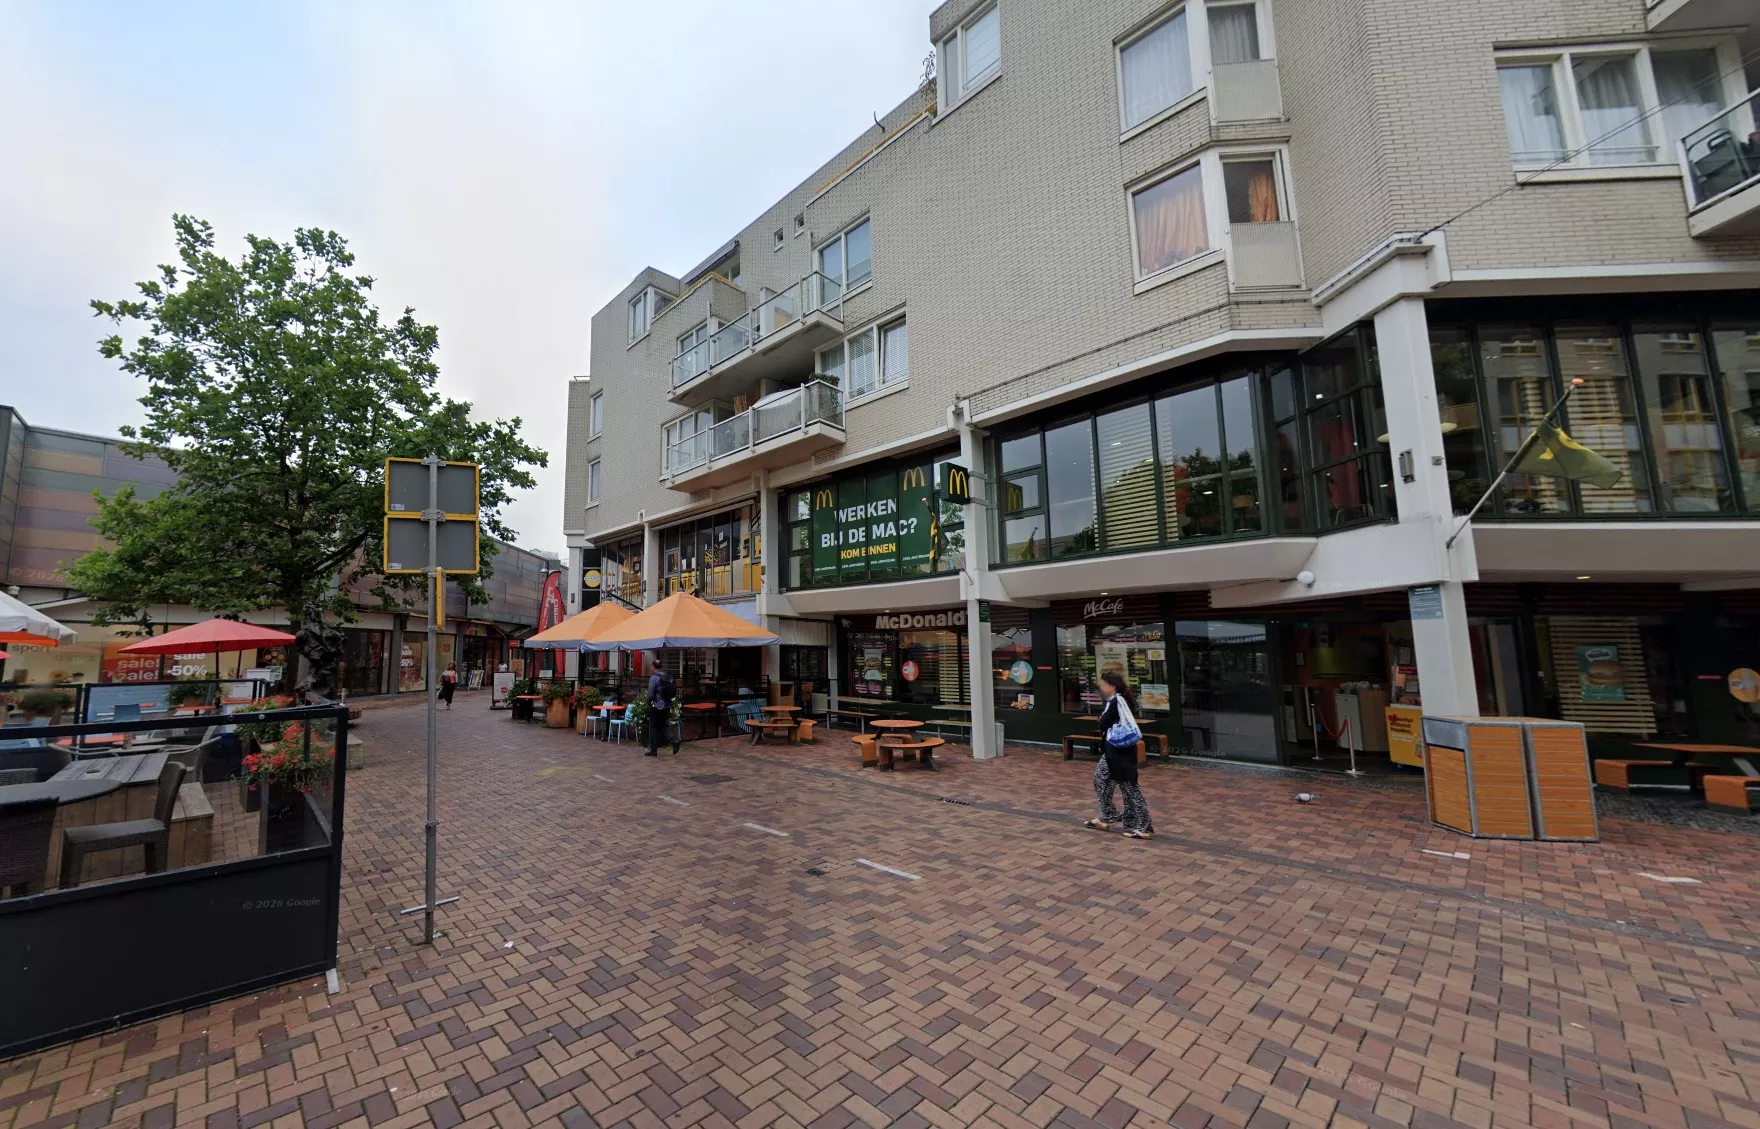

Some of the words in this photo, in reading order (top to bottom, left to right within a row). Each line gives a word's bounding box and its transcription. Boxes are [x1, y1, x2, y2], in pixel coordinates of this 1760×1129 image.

[834, 498, 897, 523] WERKEN
[821, 531, 843, 548] BIJ
[848, 526, 866, 542] DE
[872, 517, 918, 540] MAC?
[840, 548, 860, 560] KOM
[1084, 599, 1123, 618] McCafé
[876, 611, 968, 629] McDonald'
[118, 658, 160, 669] sale!
[167, 665, 207, 676] -50%
